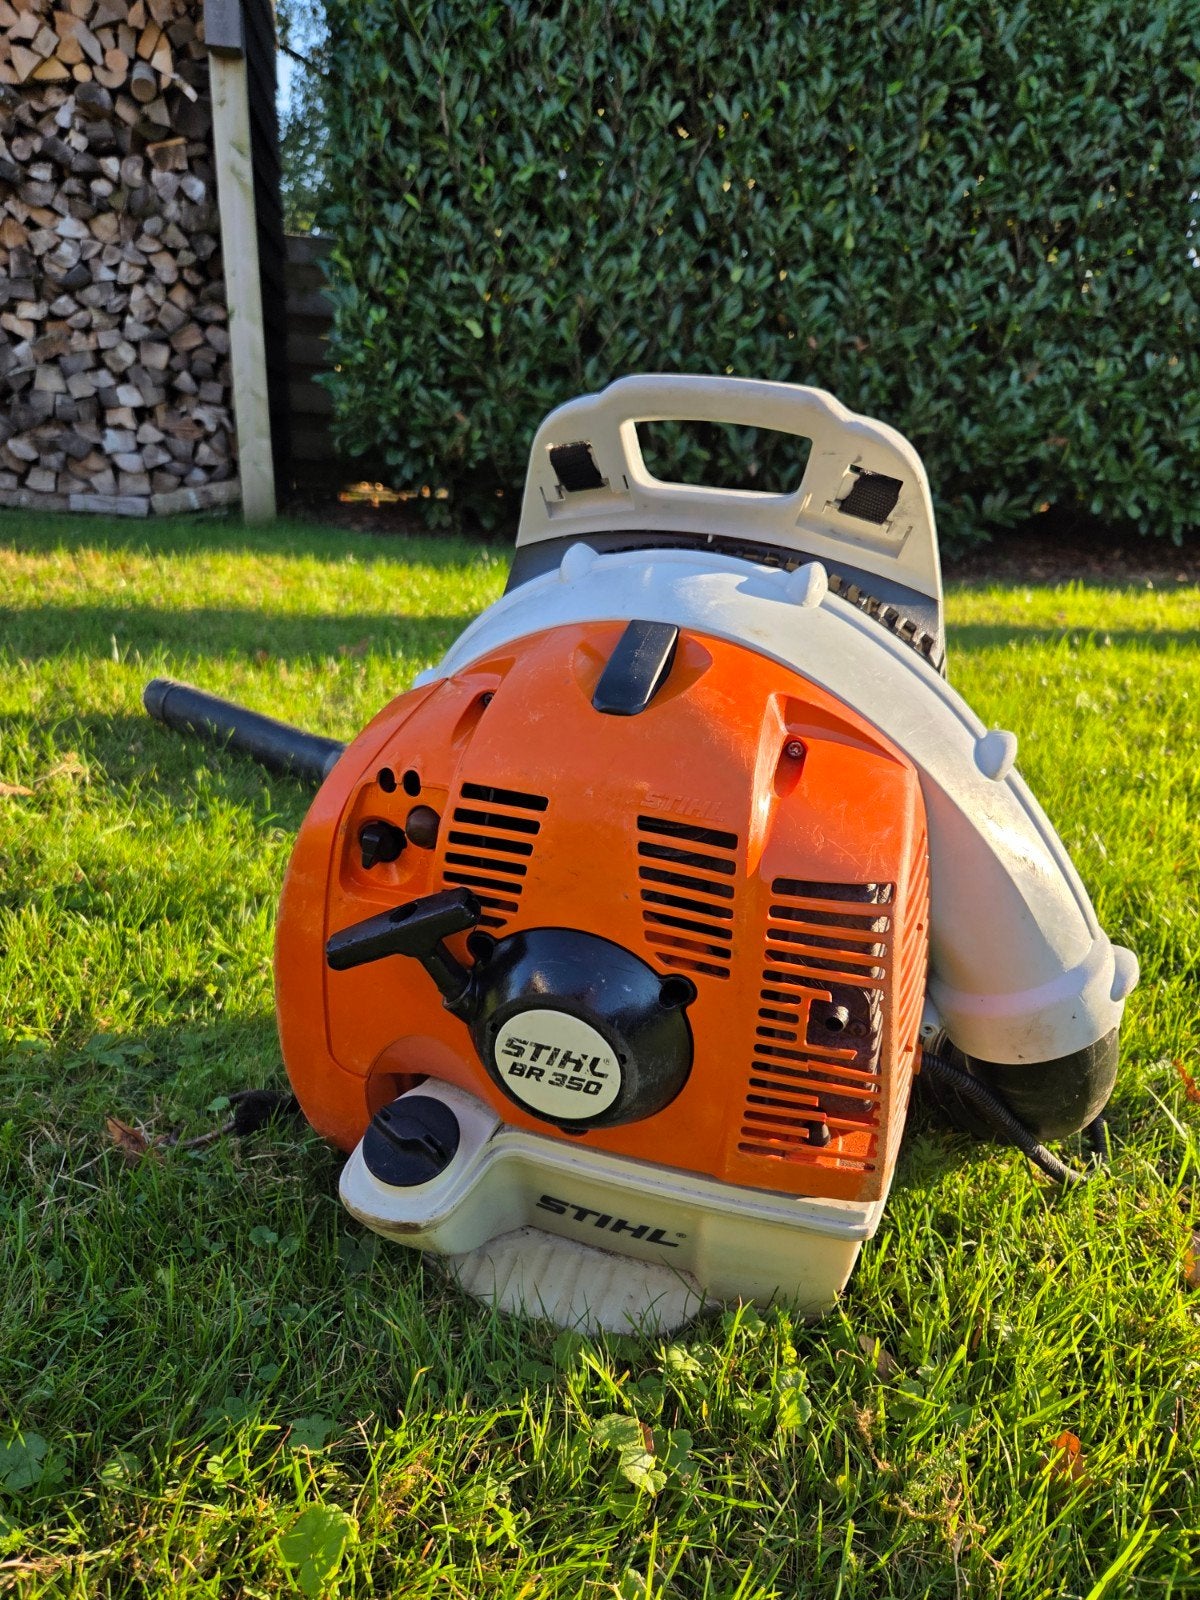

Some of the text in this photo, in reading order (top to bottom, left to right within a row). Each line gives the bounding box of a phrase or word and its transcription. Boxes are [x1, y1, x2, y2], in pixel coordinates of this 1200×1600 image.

[641, 792, 725, 821] STIHL
[502, 1037, 608, 1079] STIHL
[508, 1062, 602, 1096] BR 350
[536, 1195, 680, 1247] STIHL
